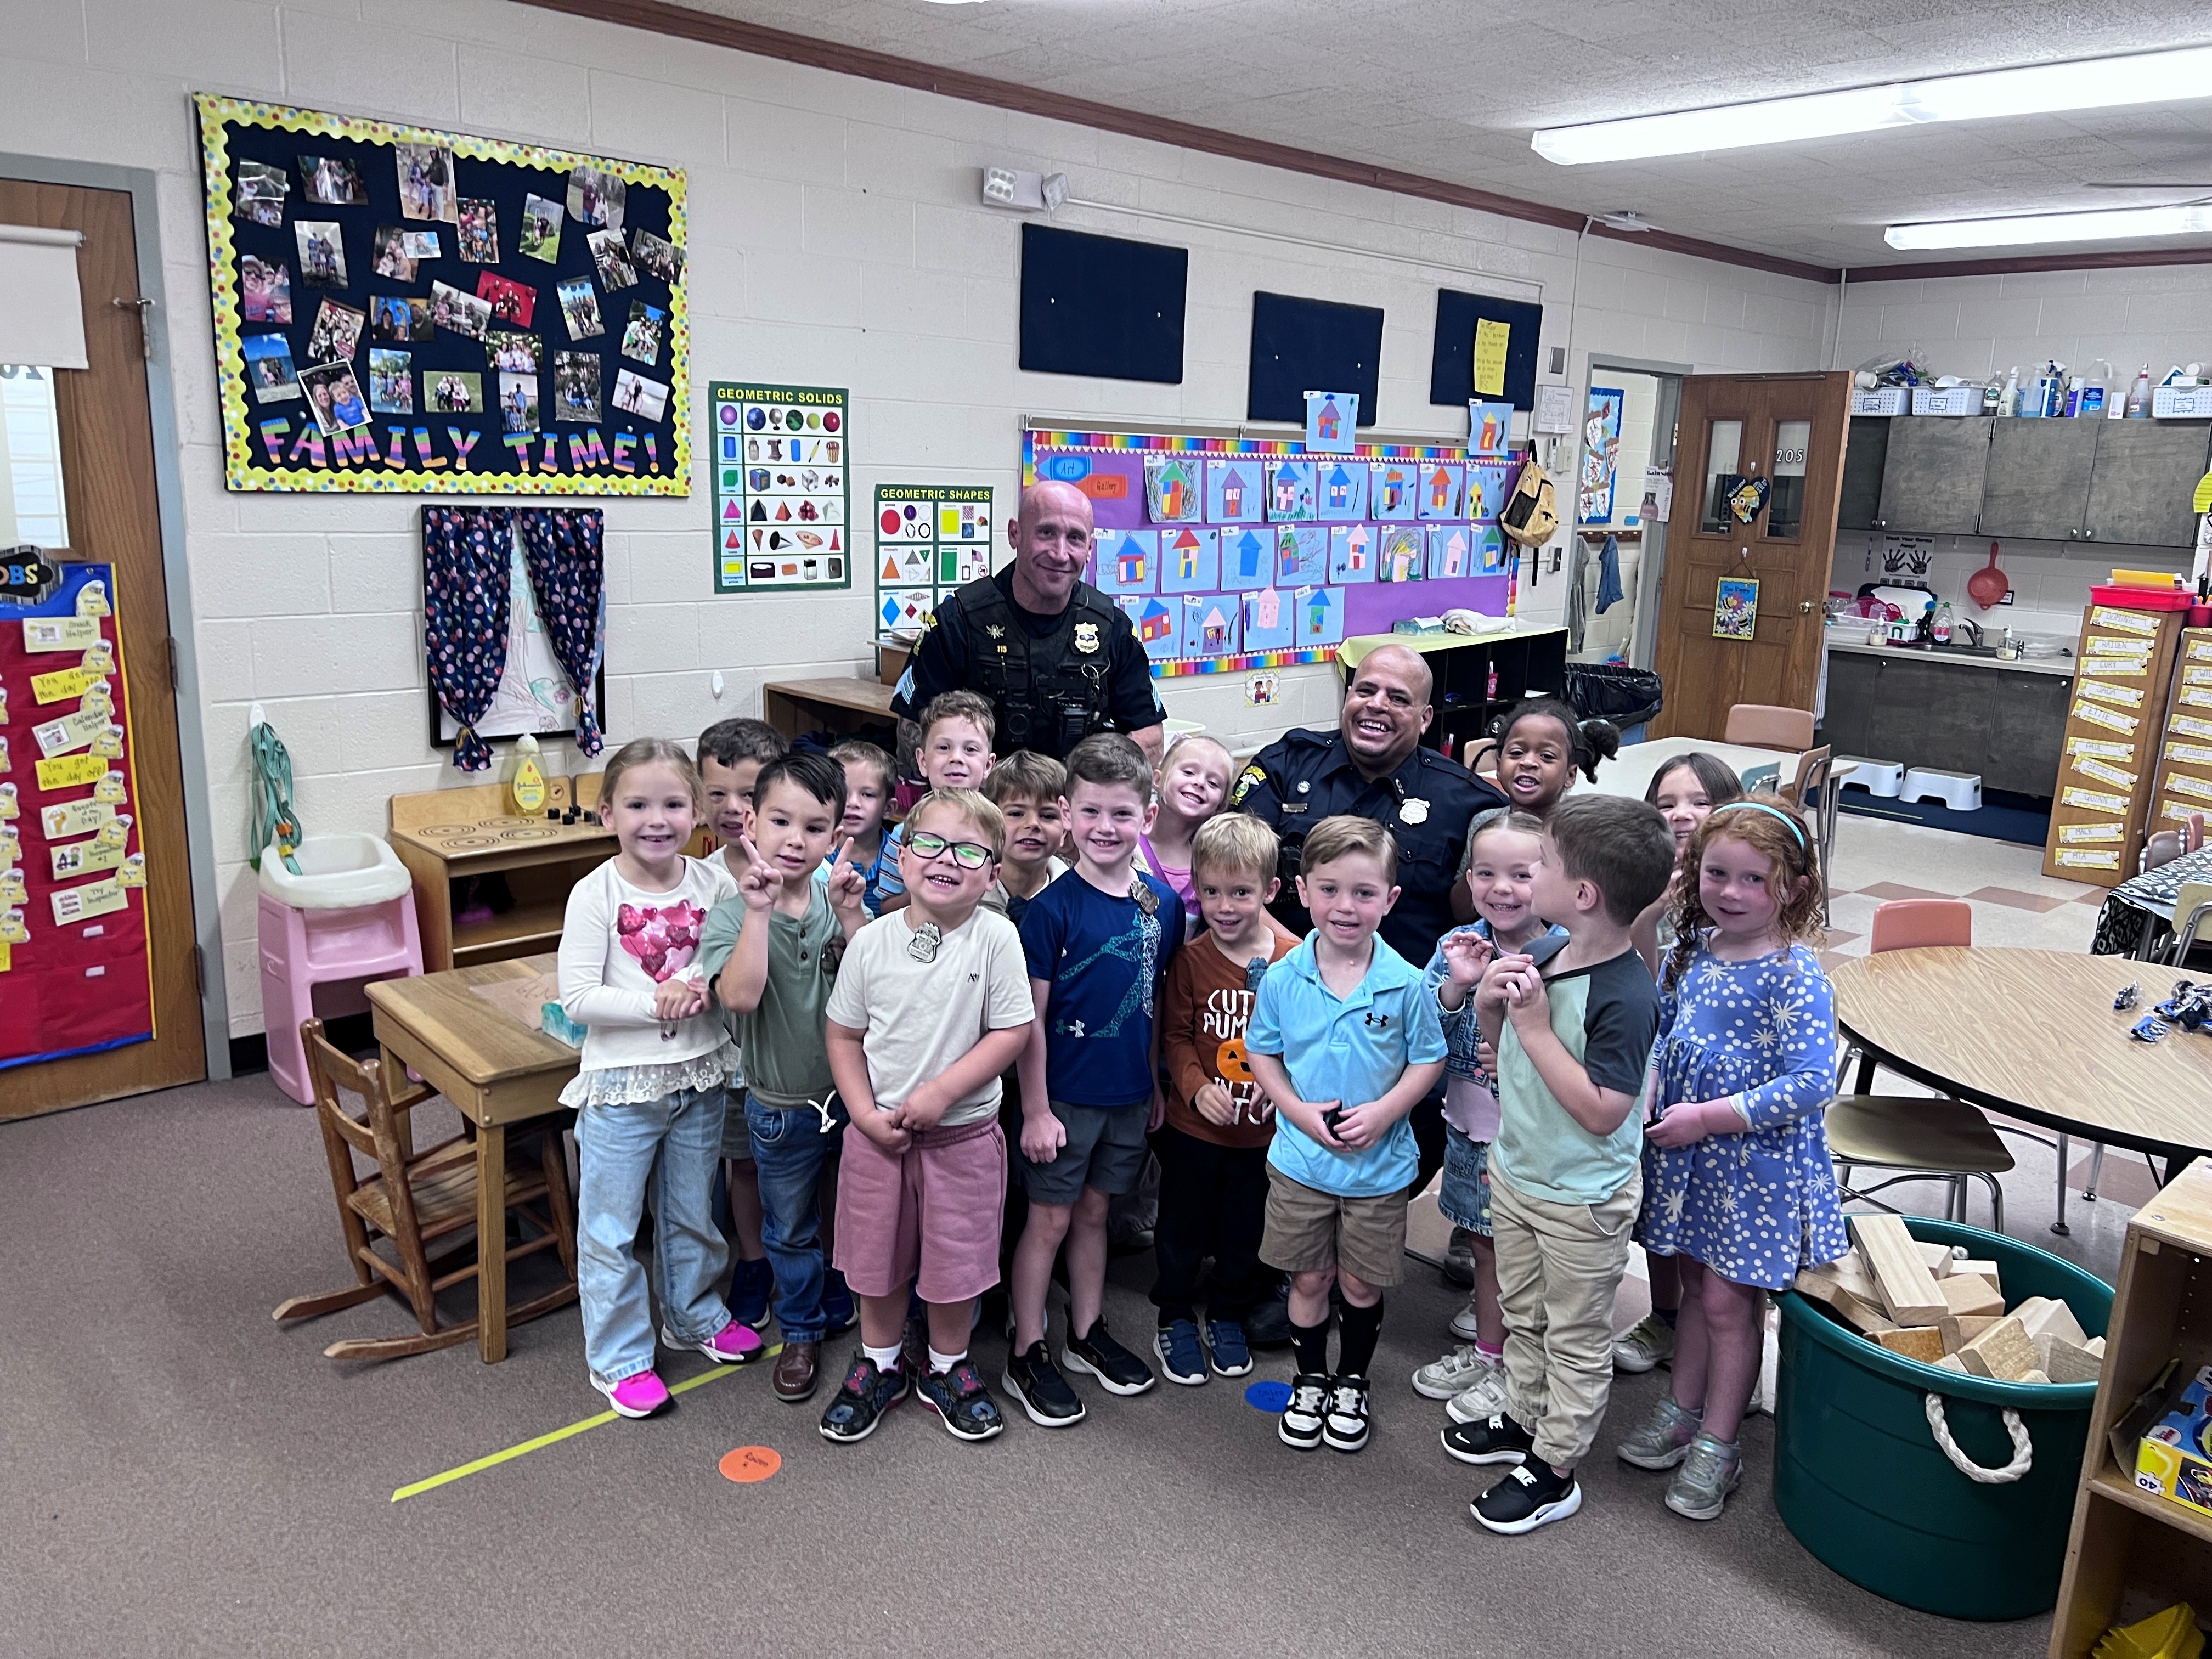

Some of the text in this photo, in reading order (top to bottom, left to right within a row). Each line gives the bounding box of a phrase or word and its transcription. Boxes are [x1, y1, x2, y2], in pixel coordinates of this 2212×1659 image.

[717, 388, 842, 404] GEOMETRIC SOLIDS
[260, 417, 659, 473] FAMILY TIME!
[1776, 449, 1804, 463] 205
[1061, 462, 1075, 475] Art
[1097, 481, 1117, 494] Gallery
[881, 489, 990, 500] GEOMETRIC SHAPES
[2107, 612, 2135, 625] DOMINIC
[38, 677, 58, 687] You
[61, 684, 77, 693] day
[2183, 748, 2206, 758] ADDIE
[44, 755, 89, 772] You get
[66, 772, 81, 783] day
[2085, 794, 2108, 804] QUINN
[1207, 989, 1255, 1015] CUT
[1203, 1012, 1251, 1040] PUM
[2139, 1478, 2157, 1489] 40
